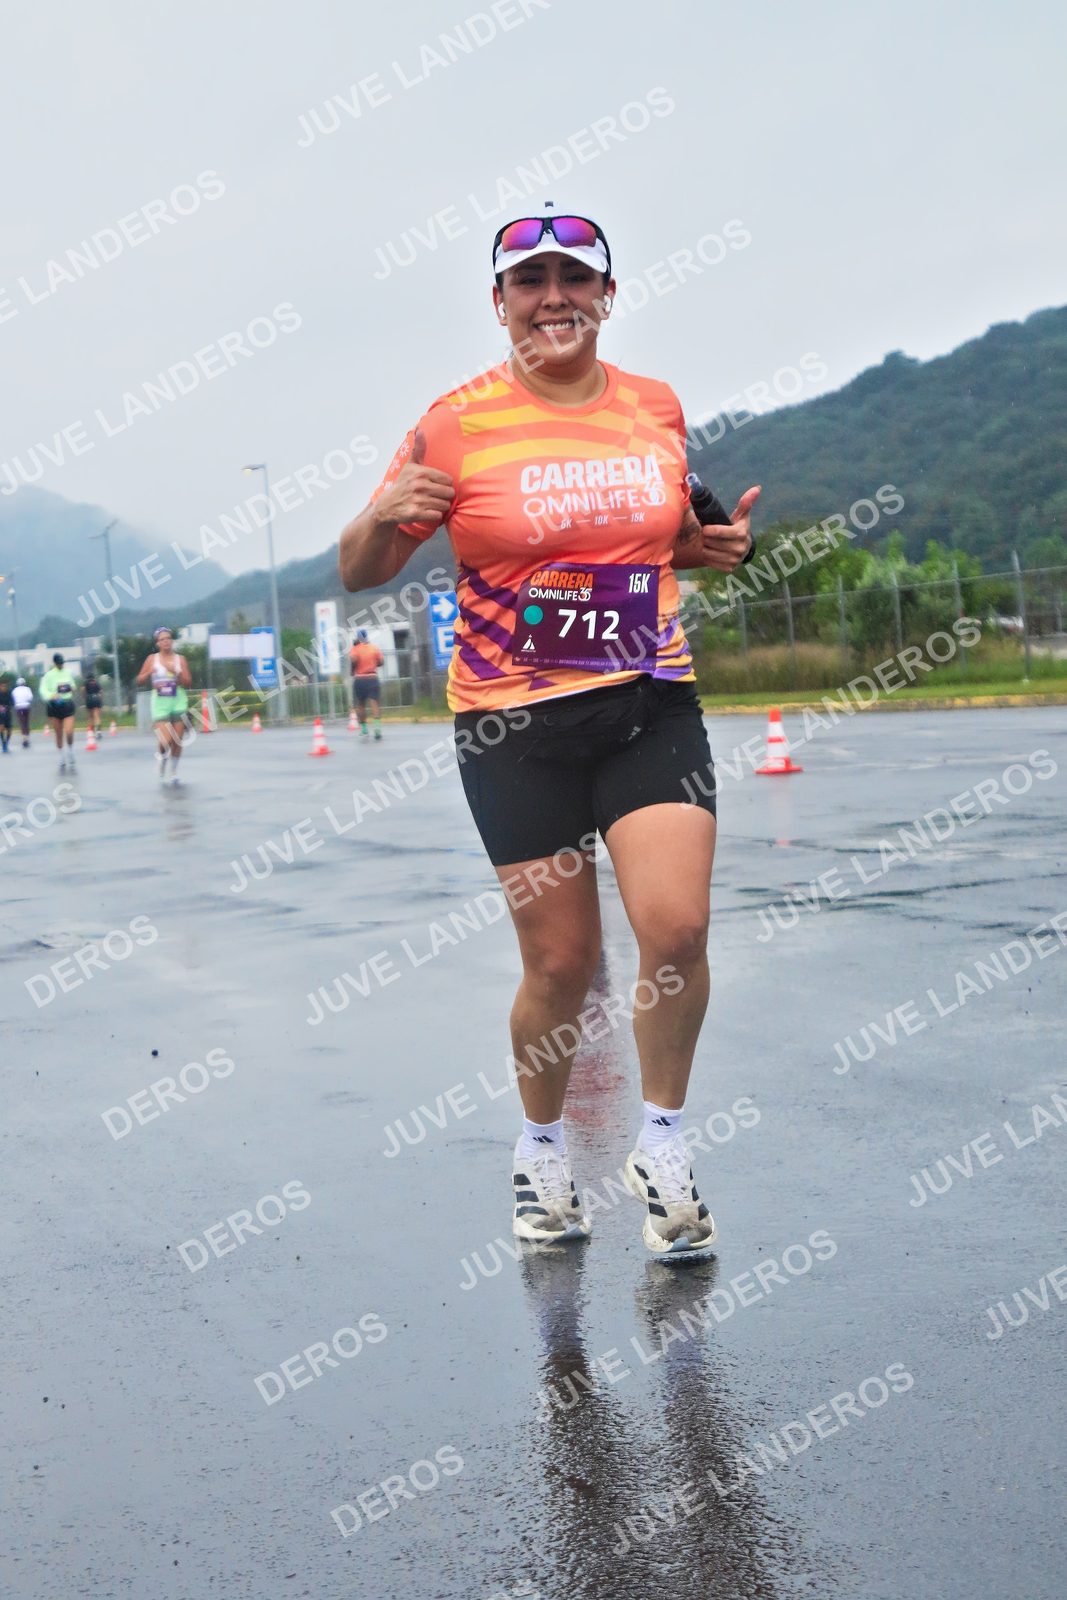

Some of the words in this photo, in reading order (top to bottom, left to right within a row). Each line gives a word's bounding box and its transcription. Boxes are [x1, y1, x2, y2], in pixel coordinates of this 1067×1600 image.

[521, 454, 663, 494] CARRERA
[594, 515, 609, 526] 10K
[631, 511, 645, 523] 15K
[530, 570, 594, 588] CARRERA
[628, 573, 651, 593] 15K
[558, 608, 620, 640] 712
